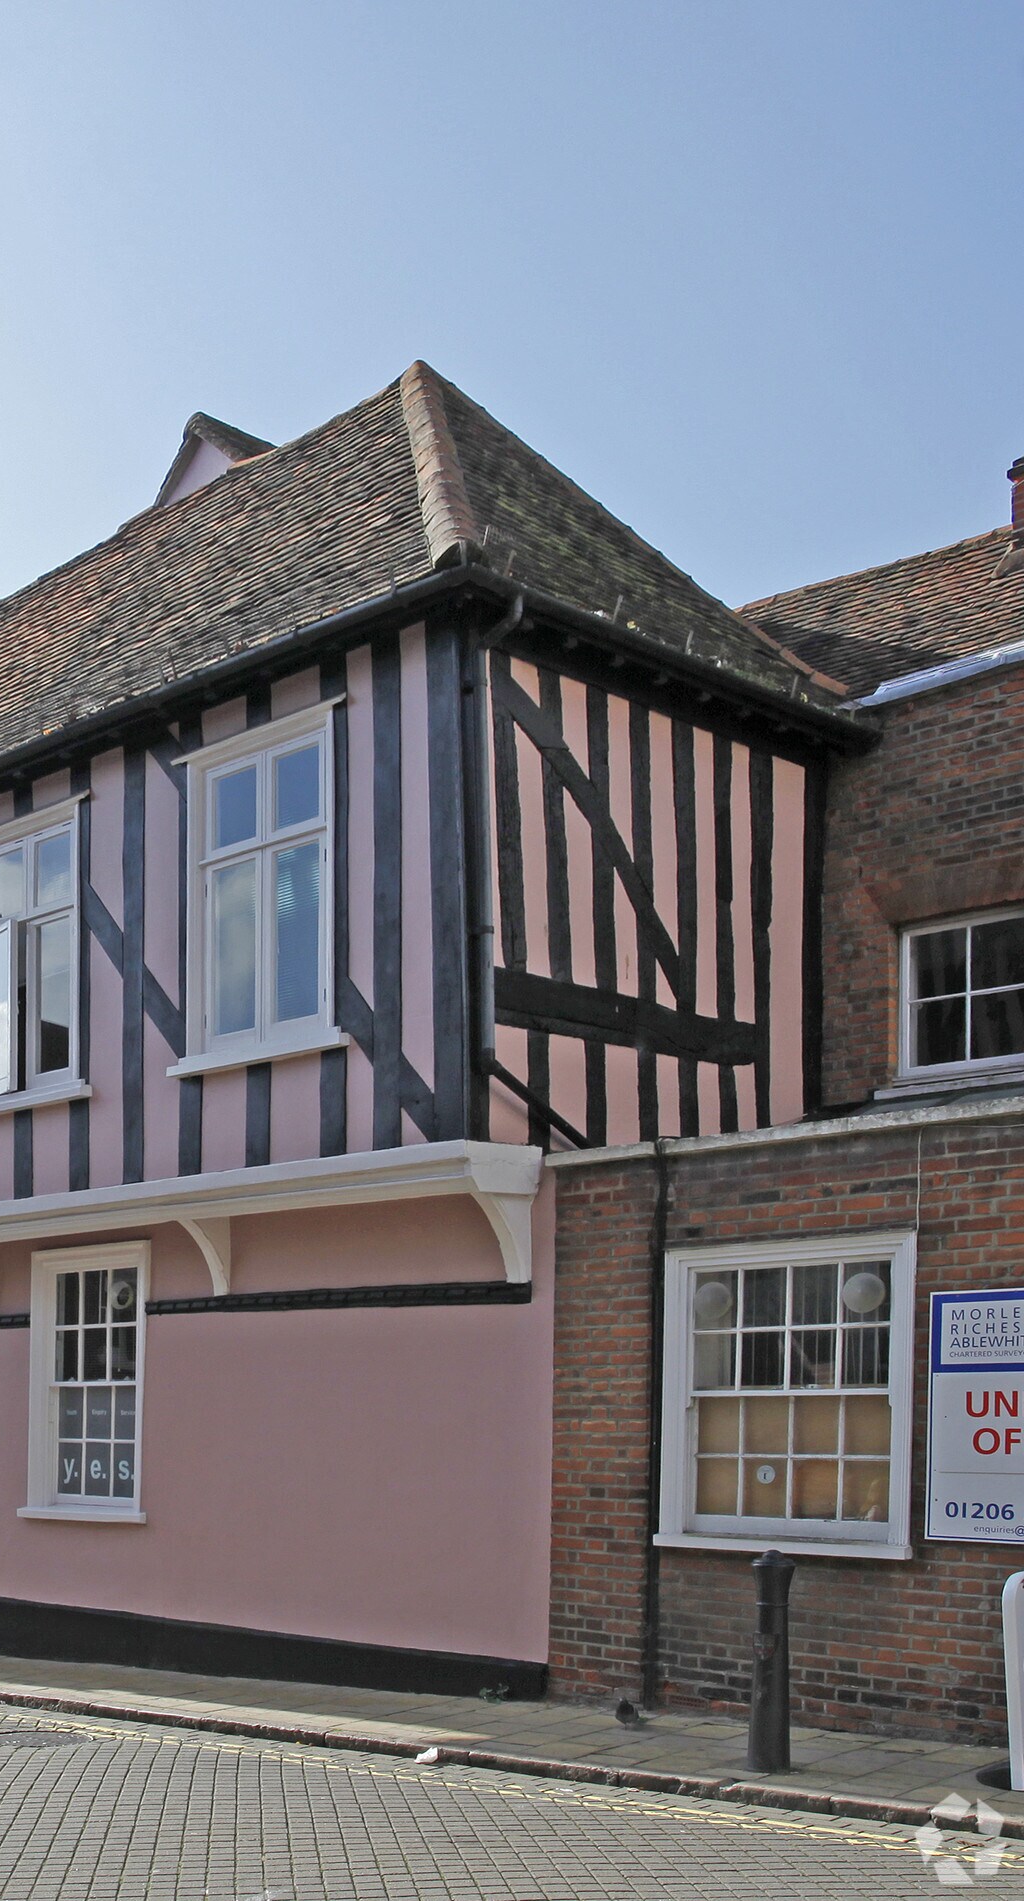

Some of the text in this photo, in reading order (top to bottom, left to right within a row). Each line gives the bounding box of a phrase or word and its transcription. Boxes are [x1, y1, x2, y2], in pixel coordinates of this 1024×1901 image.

[951, 1307, 1021, 1320] MORLE
[950, 1322, 1021, 1335] RICHES
[949, 1350, 993, 1358] CHARTERED
[965, 1390, 1019, 1418] UN
[972, 1427, 1022, 1455] OF
[945, 1501, 1015, 1520] 01206
